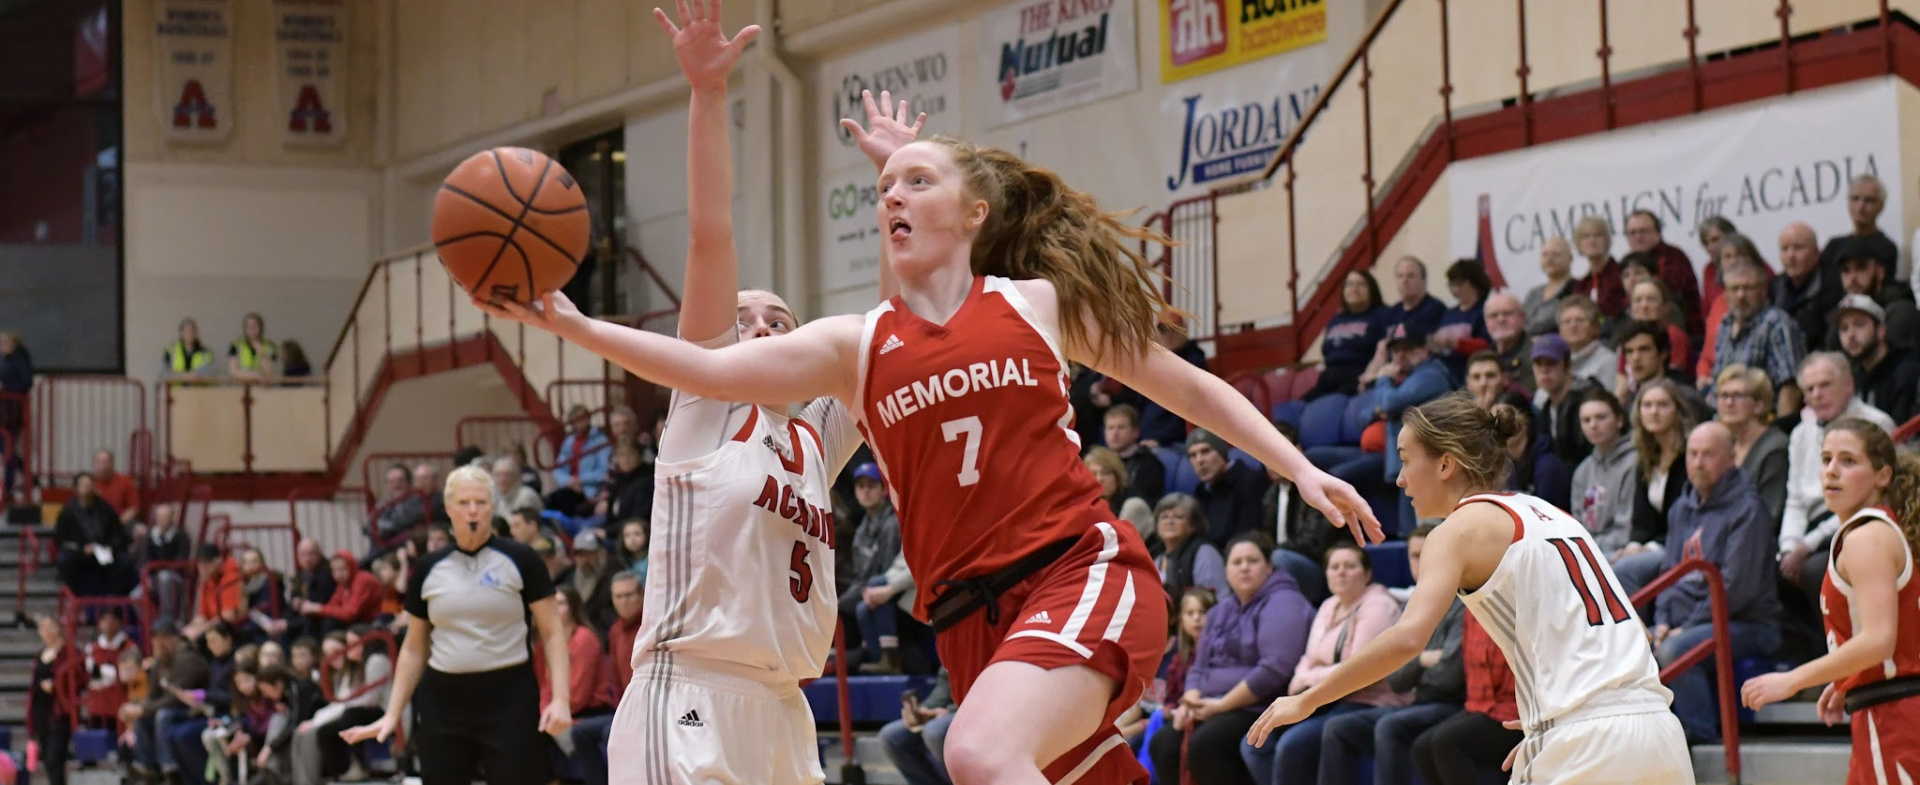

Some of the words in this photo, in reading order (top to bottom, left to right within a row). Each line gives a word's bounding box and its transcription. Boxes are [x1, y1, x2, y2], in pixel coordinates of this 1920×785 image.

[1020, 2, 1052, 34] THE
[1240, 0, 1320, 24] Ho
[998, 11, 1108, 82] Mutual
[1167, 84, 1319, 191] JORDAN'
[829, 183, 857, 219] GO
[1689, 182, 1728, 237] for
[876, 357, 1038, 428] MEMORIAL
[941, 415, 983, 487] 7
[1529, 505, 1555, 521] A
[789, 540, 813, 604] 5
[1545, 537, 1632, 627] 11
[678, 719, 704, 728] adidas
